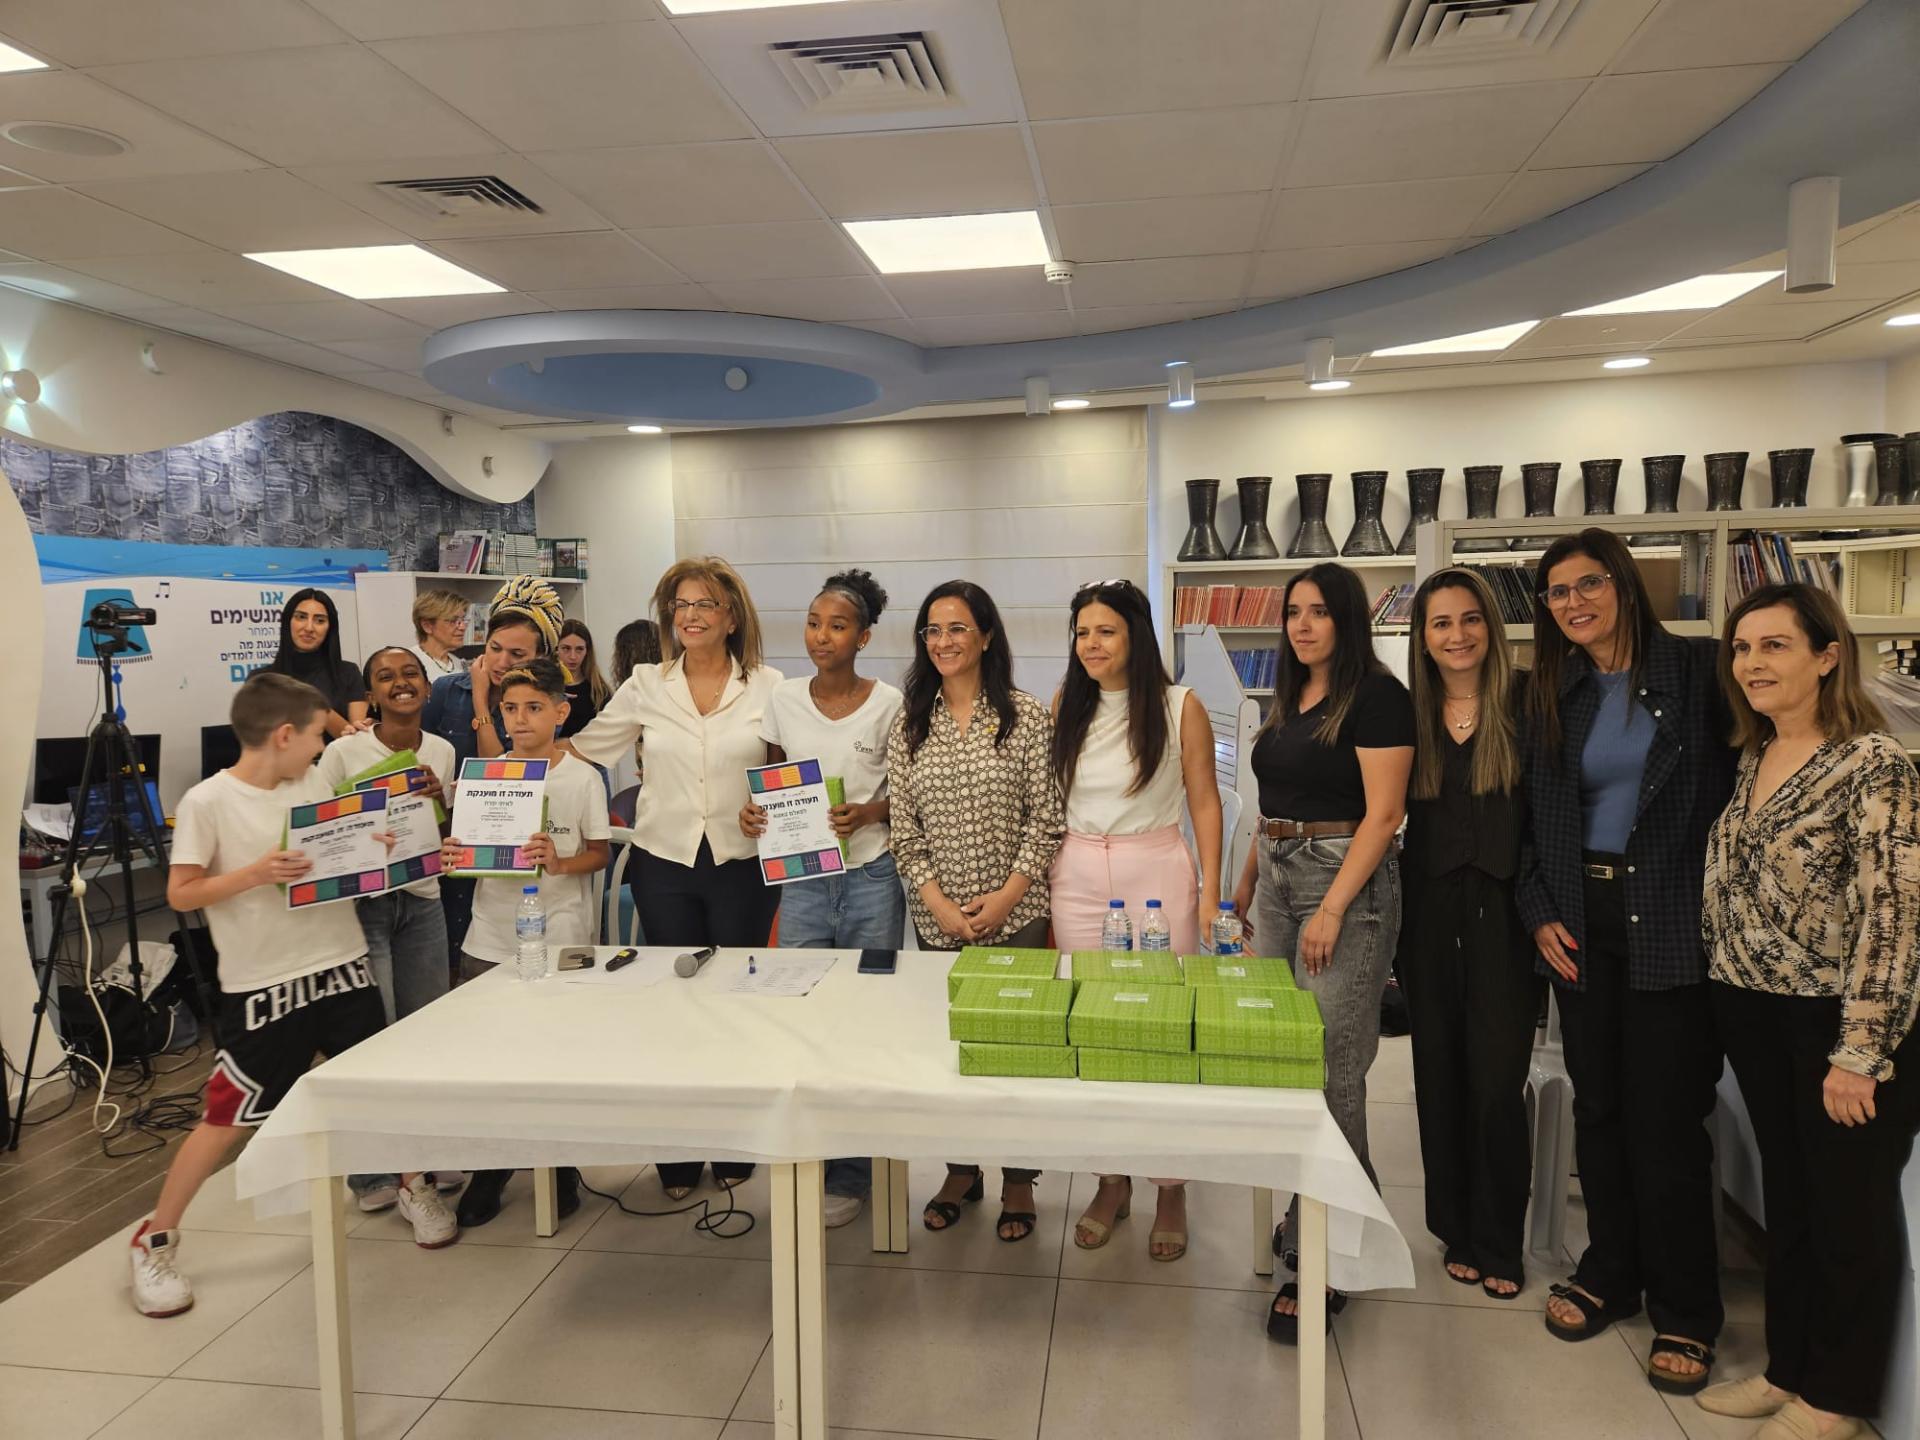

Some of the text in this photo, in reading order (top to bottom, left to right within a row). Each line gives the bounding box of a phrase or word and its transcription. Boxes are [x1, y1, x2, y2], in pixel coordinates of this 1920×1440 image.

[260, 591, 284, 605] אנו
[210, 608, 283, 624] מגשימים
[248, 627, 275, 636] המחר
[239, 641, 253, 649] מה
[220, 651, 253, 662] לומדים
[466, 790, 497, 798] מוענקת
[507, 790, 533, 798] תעודה
[794, 796, 819, 806] תעודה
[245, 956, 377, 1031] CHICAG
